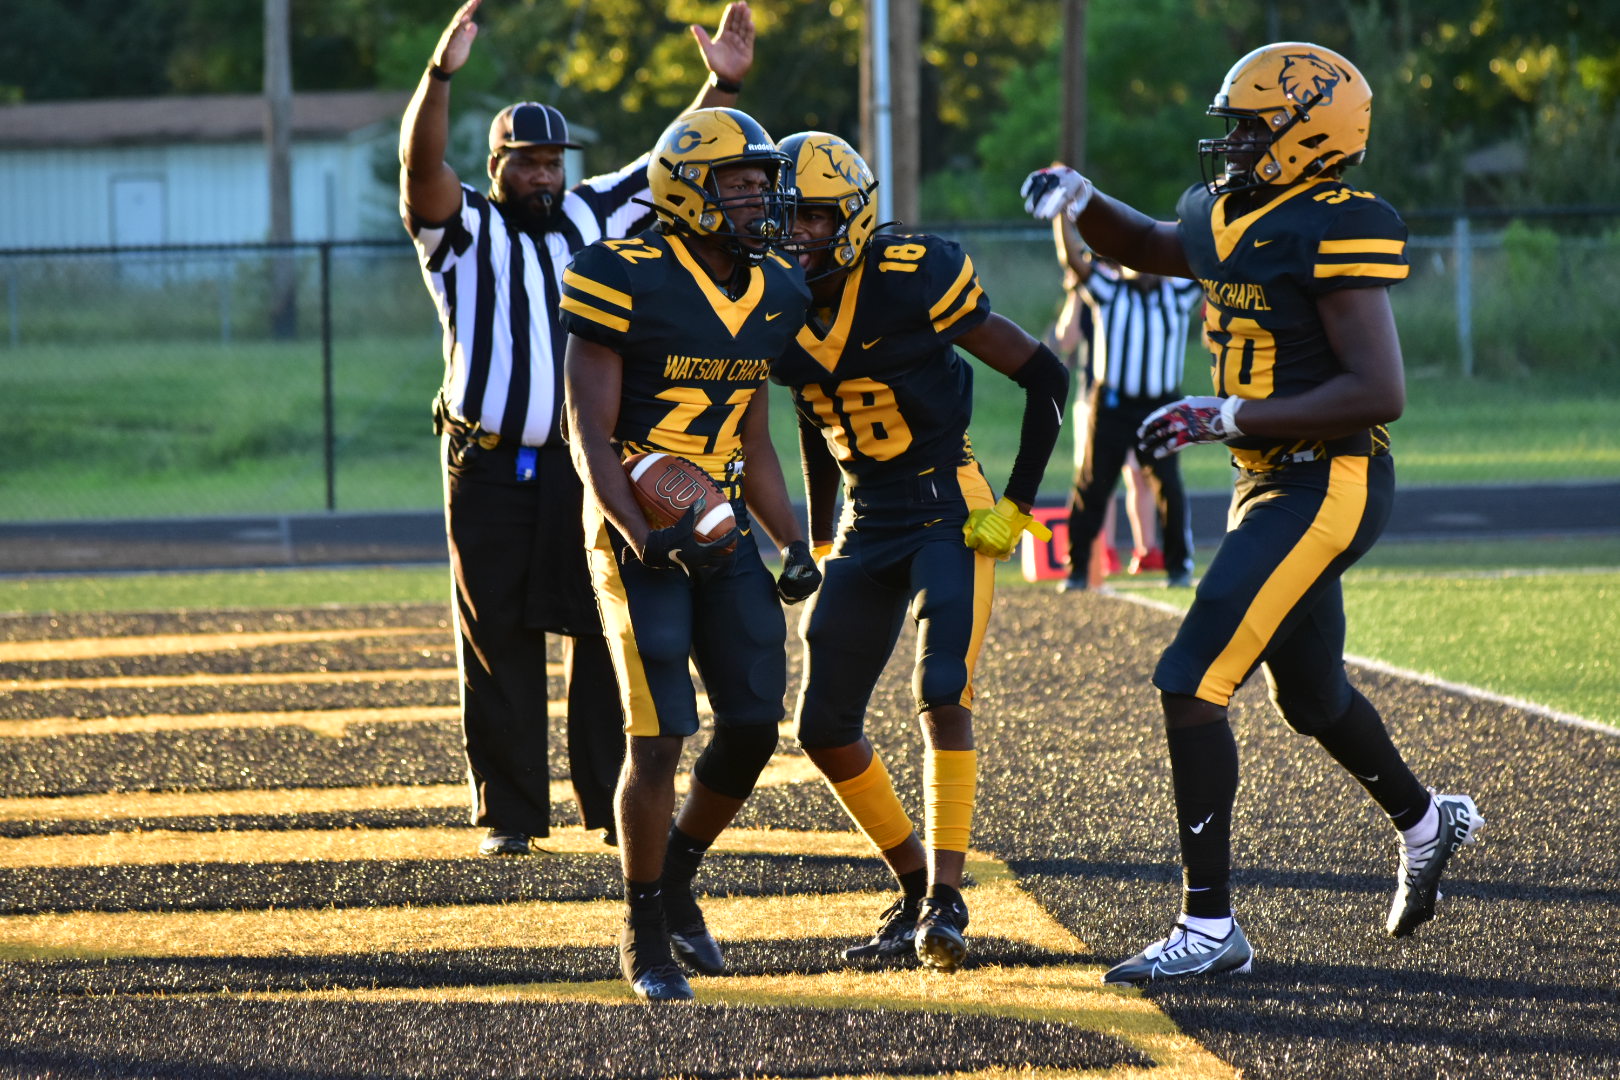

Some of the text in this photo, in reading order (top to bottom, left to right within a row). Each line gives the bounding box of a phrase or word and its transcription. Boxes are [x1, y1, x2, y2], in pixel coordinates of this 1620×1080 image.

[602, 238, 662, 264] 22
[878, 243, 926, 273] 18
[1219, 283, 1272, 310] CHAPEL
[663, 354, 730, 380] WATSON
[801, 377, 913, 462] 18
